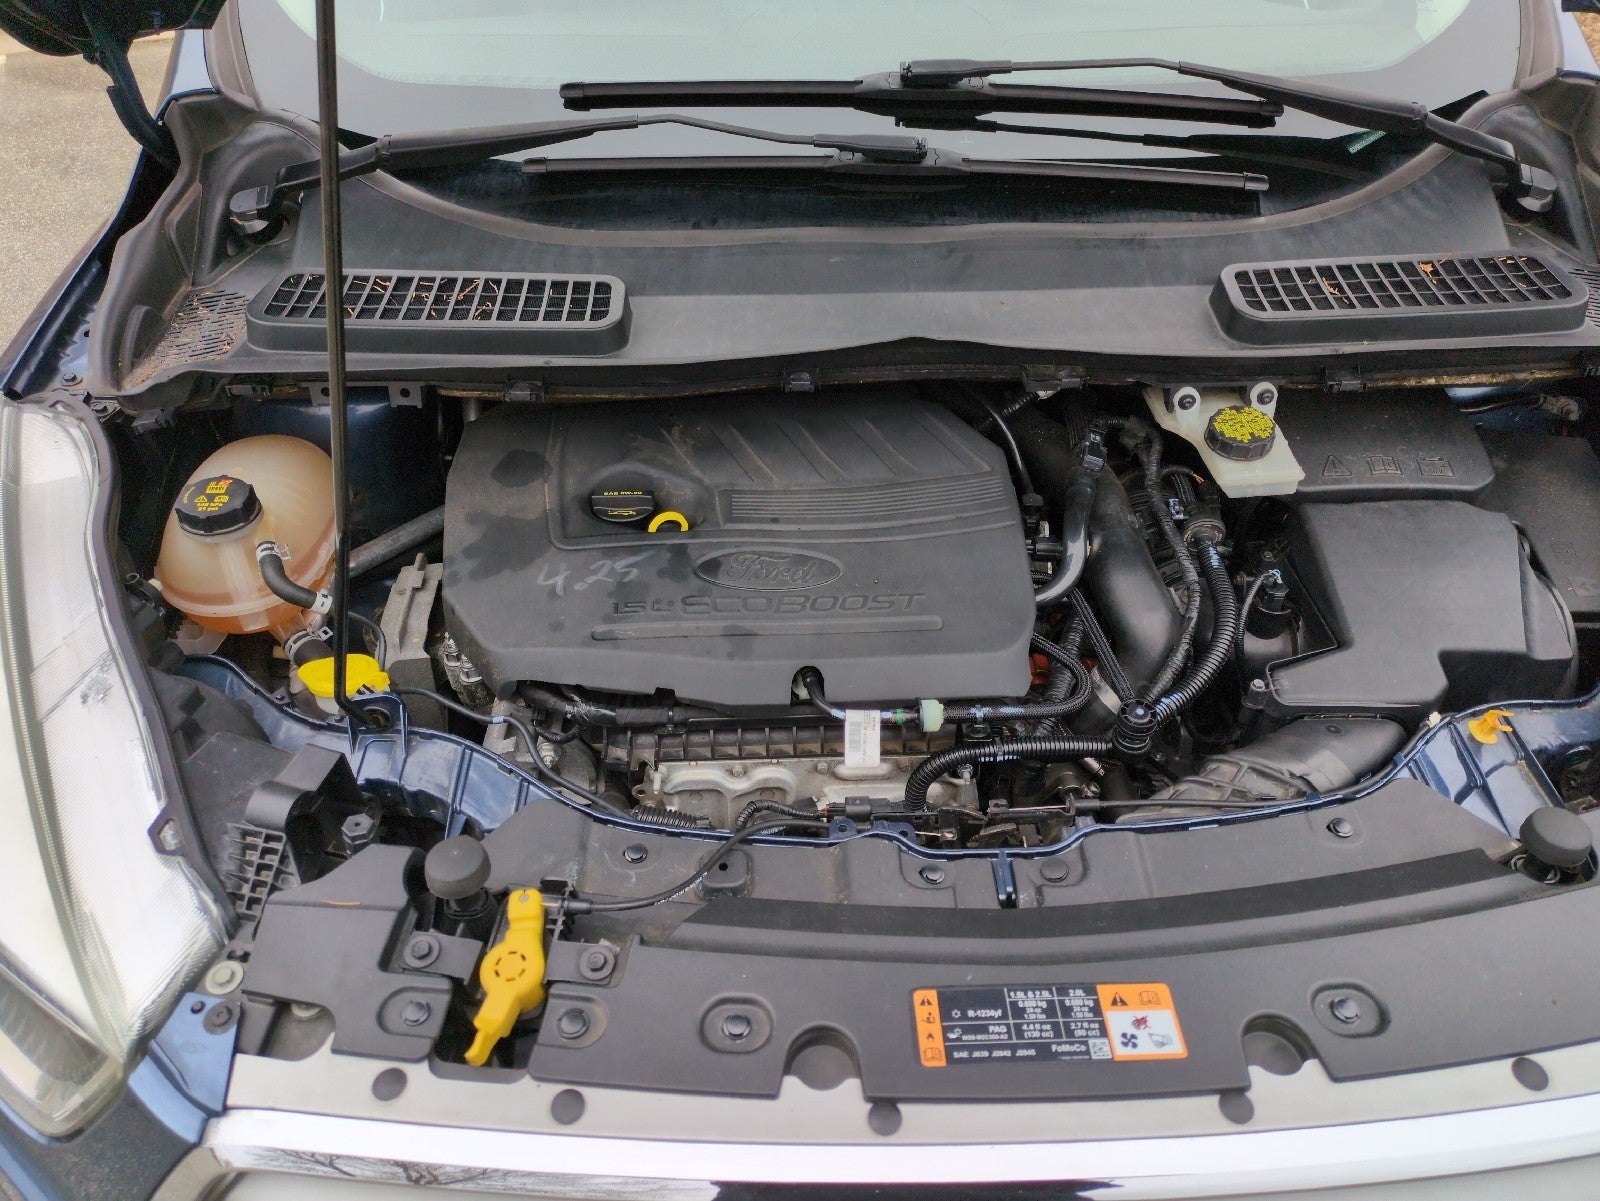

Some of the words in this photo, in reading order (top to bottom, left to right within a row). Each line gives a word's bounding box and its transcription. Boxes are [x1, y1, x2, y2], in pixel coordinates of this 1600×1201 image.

[726, 554, 819, 584] Ford
[679, 592, 927, 616] ECOBOOST
[967, 1009, 1002, 1019] R-1234yf
[988, 1025, 1008, 1033] PAG
[1051, 1043, 1088, 1053] FoMoCo
[953, 1051, 970, 1059] SAE
